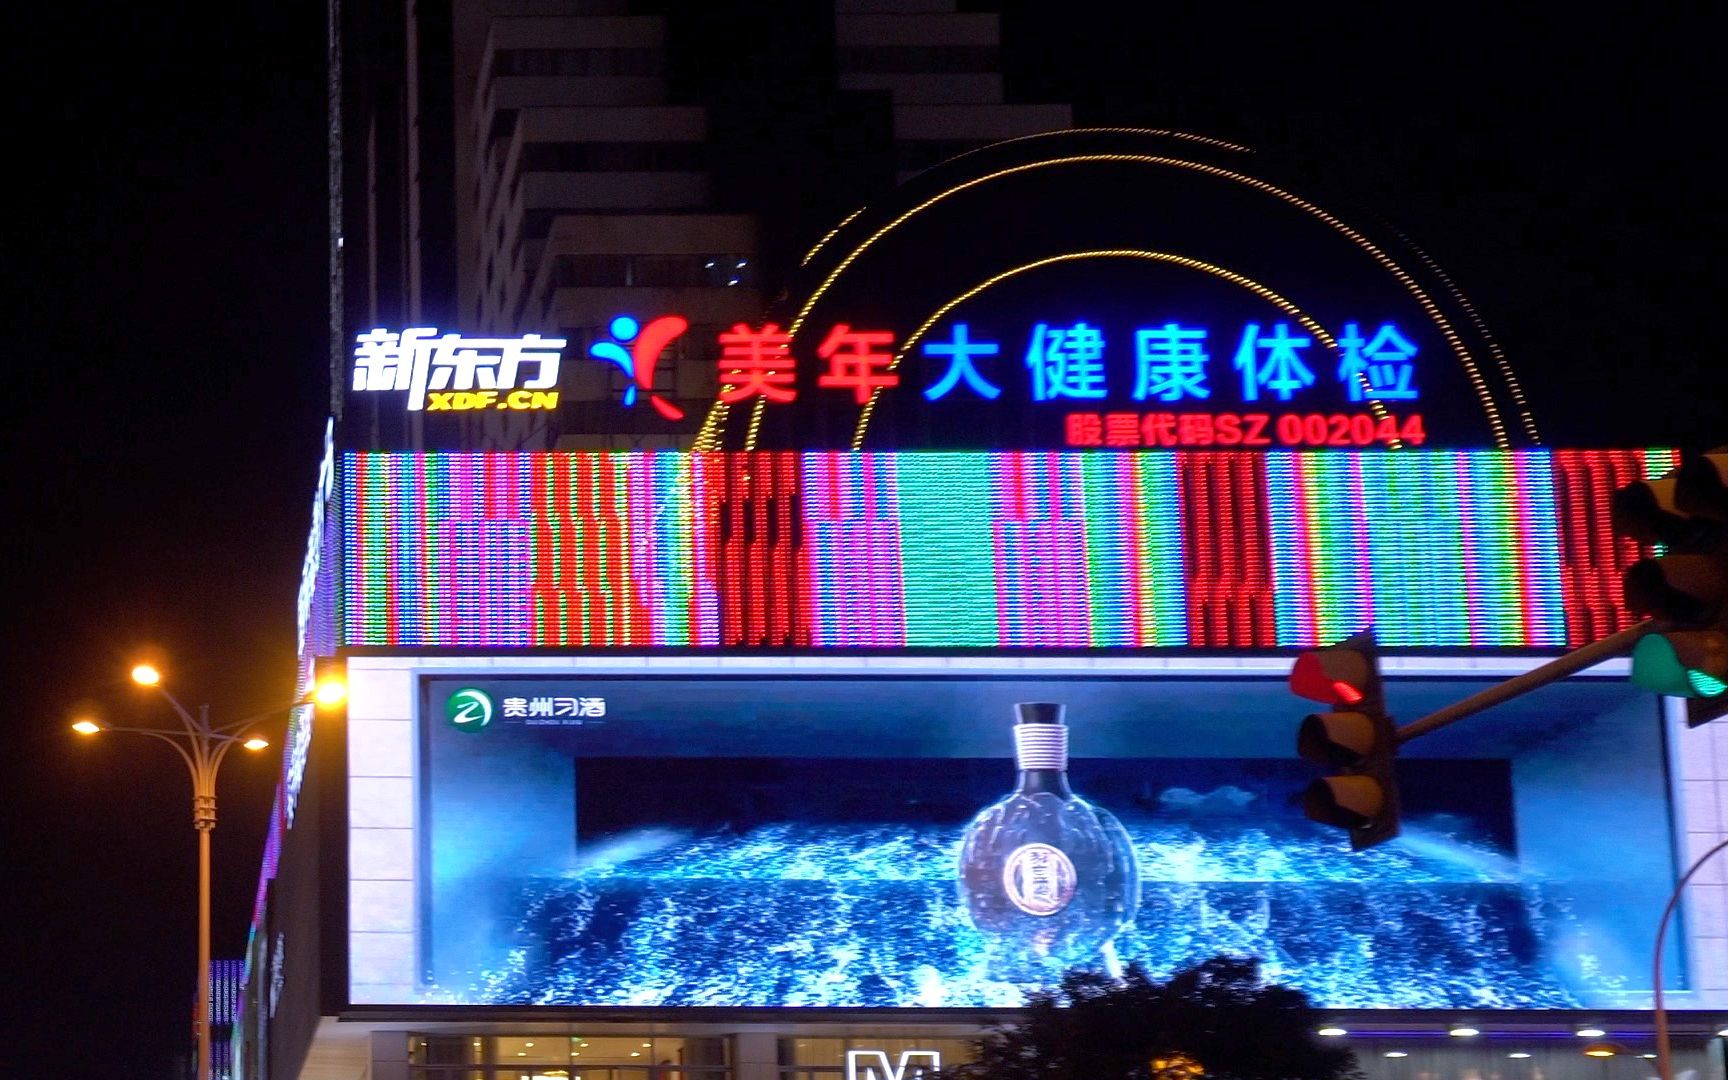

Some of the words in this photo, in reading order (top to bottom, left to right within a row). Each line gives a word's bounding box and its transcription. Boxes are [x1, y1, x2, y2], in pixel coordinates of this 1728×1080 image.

[353, 327, 567, 410] 新东方
[718, 322, 1421, 404] 美年大健康体检
[426, 390, 560, 411] XDF.CN
[1278, 412, 1426, 447] 002044
[502, 696, 607, 718] 贵州习酒
